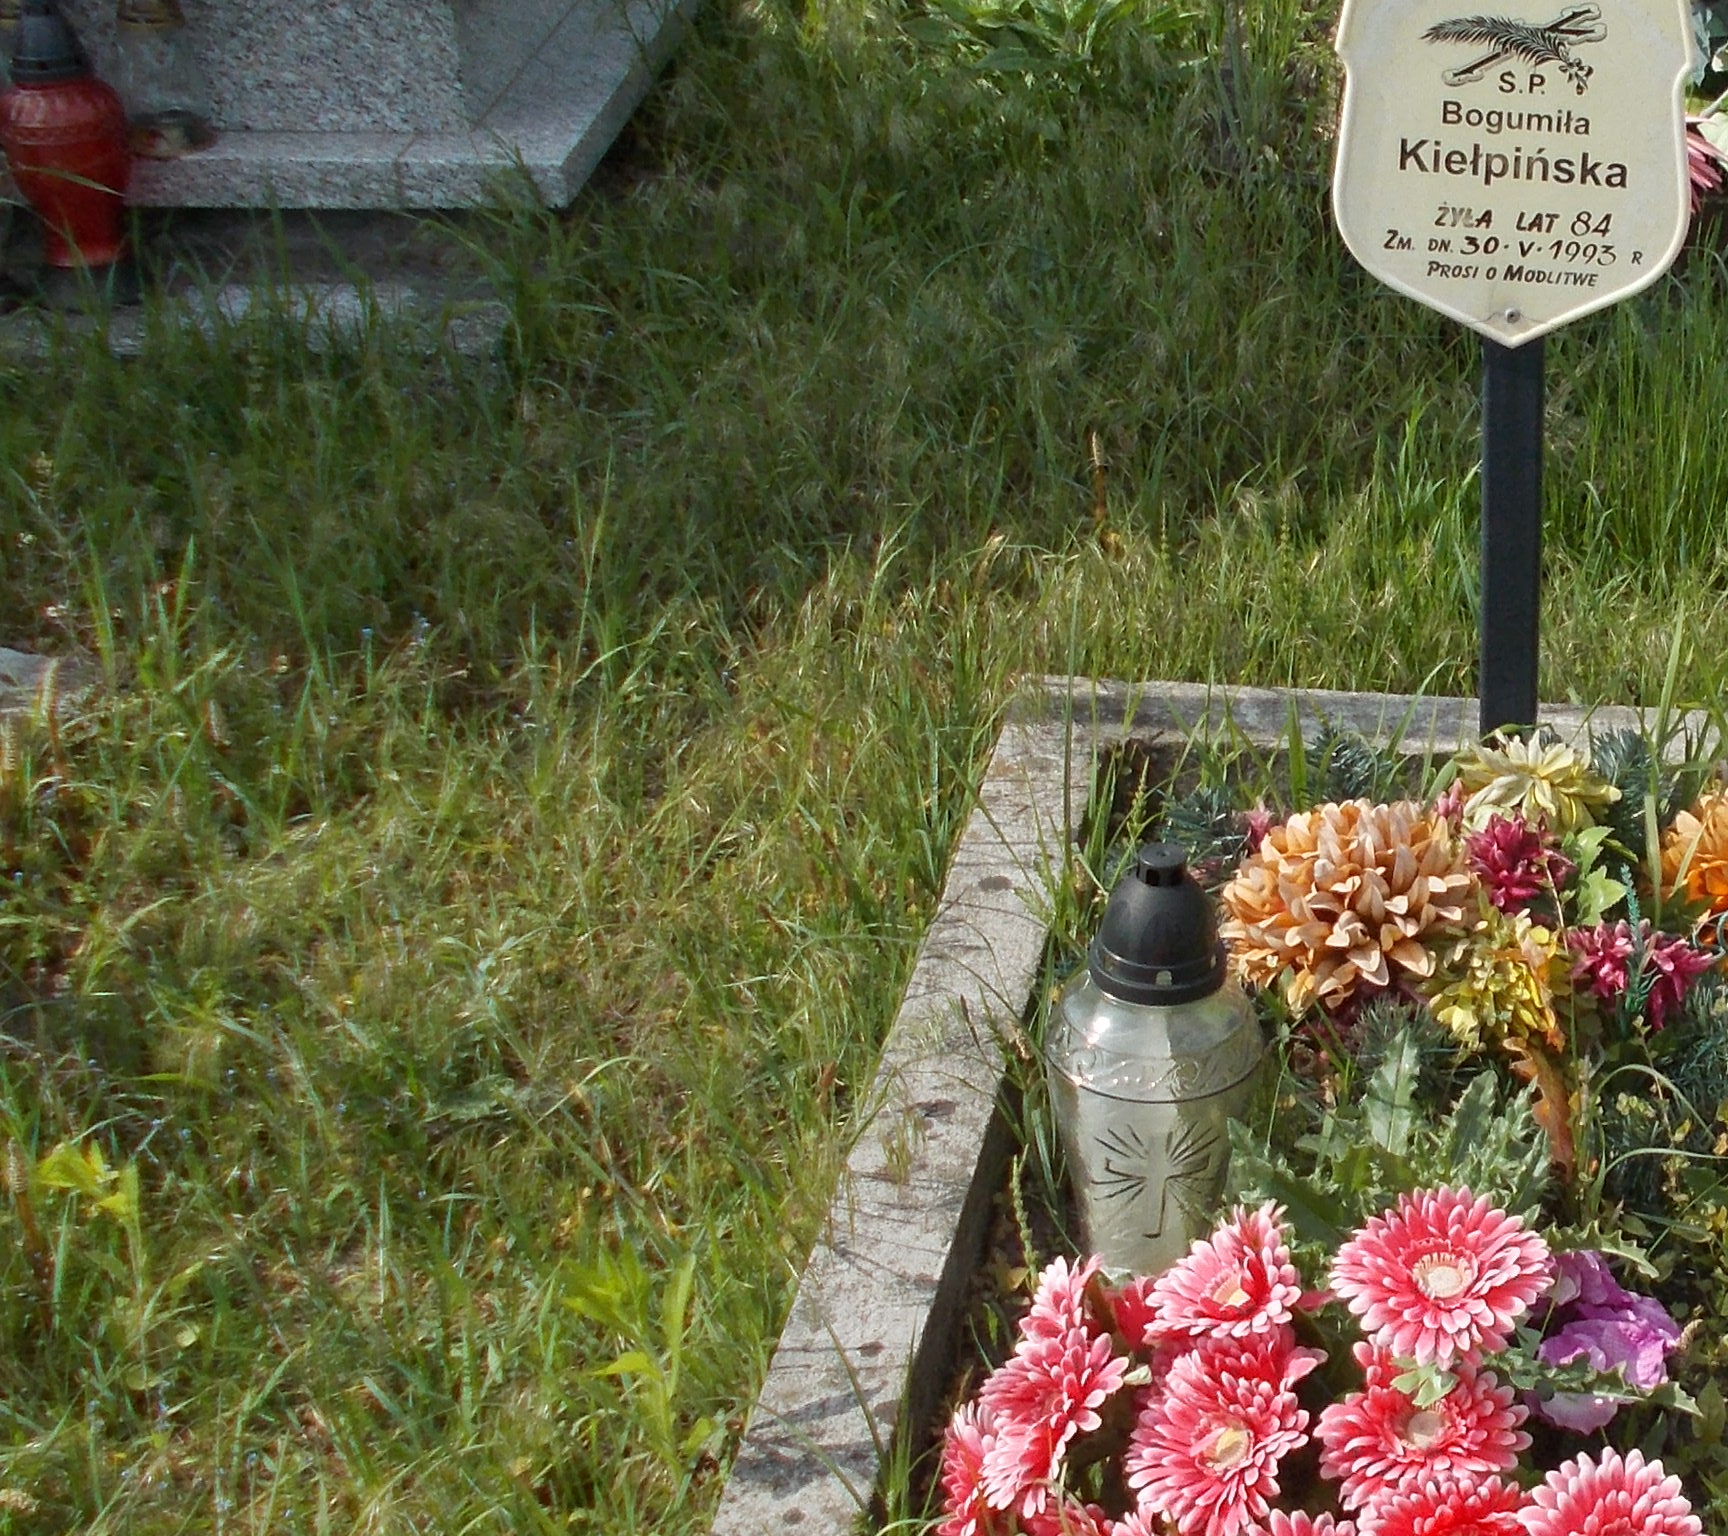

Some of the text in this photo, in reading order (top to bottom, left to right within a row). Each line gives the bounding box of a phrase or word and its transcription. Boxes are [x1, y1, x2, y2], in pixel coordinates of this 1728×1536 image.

[1441, 100, 1591, 135] Bogumiła
[1399, 137, 1628, 189] Kiełpińska
[1434, 201, 1612, 238] ŻYŁA LAT 84
[1486, 266, 1497, 280] O
[1631, 250, 1643, 265] R
